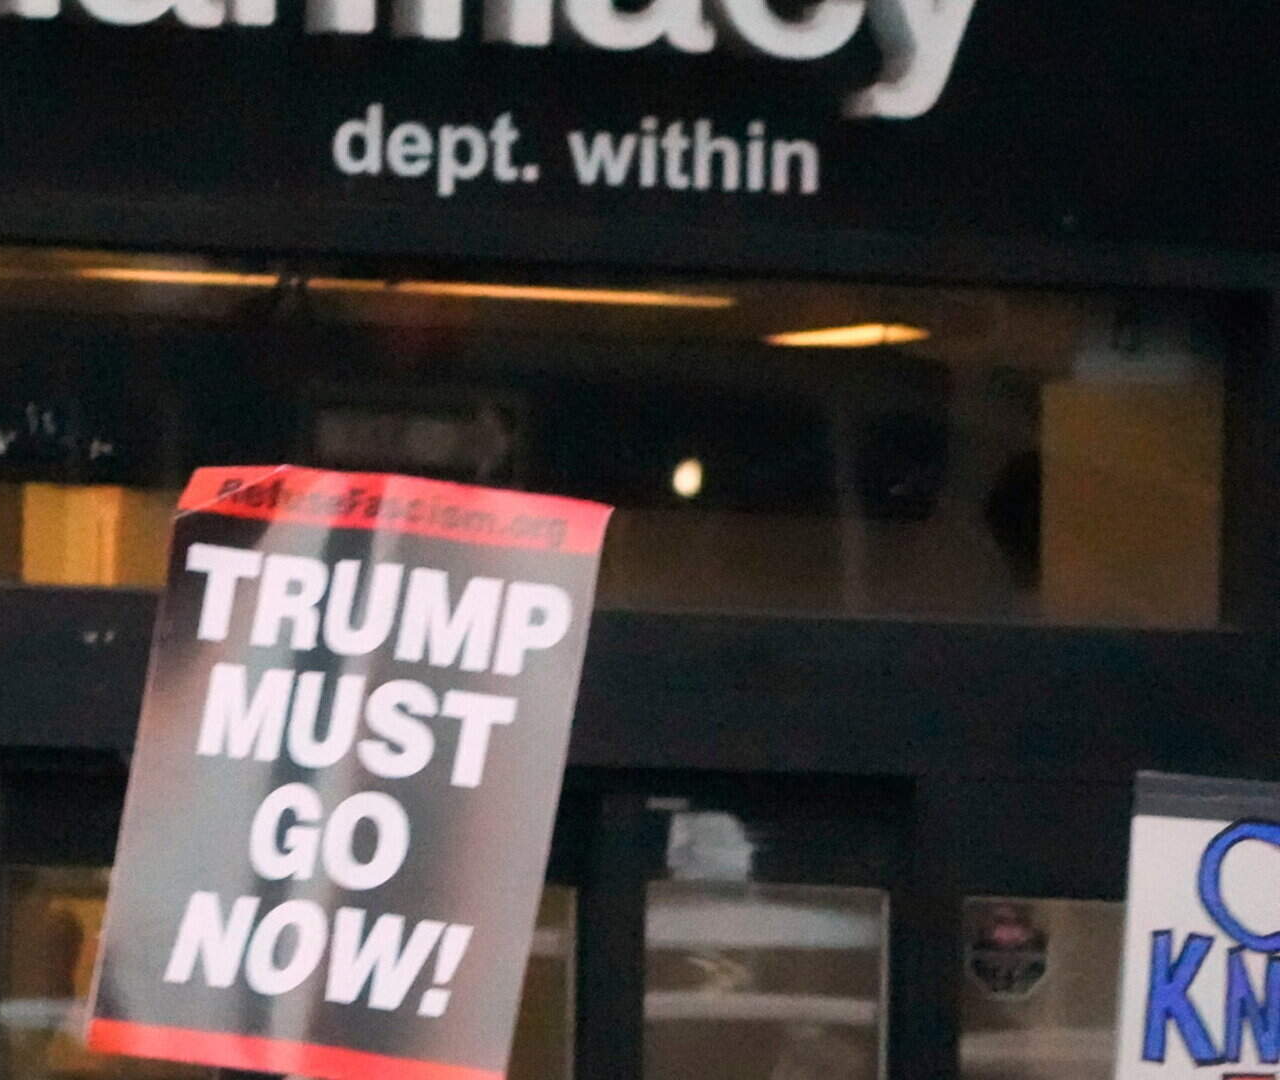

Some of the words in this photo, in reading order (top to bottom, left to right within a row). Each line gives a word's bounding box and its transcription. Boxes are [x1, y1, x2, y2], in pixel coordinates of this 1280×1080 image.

[332, 103, 540, 197] dept.
[567, 117, 819, 194] within
[186, 543, 572, 676] TRUMP
[197, 663, 517, 788] MUST
[249, 782, 411, 890] GO
[163, 891, 474, 1019] NOW!
